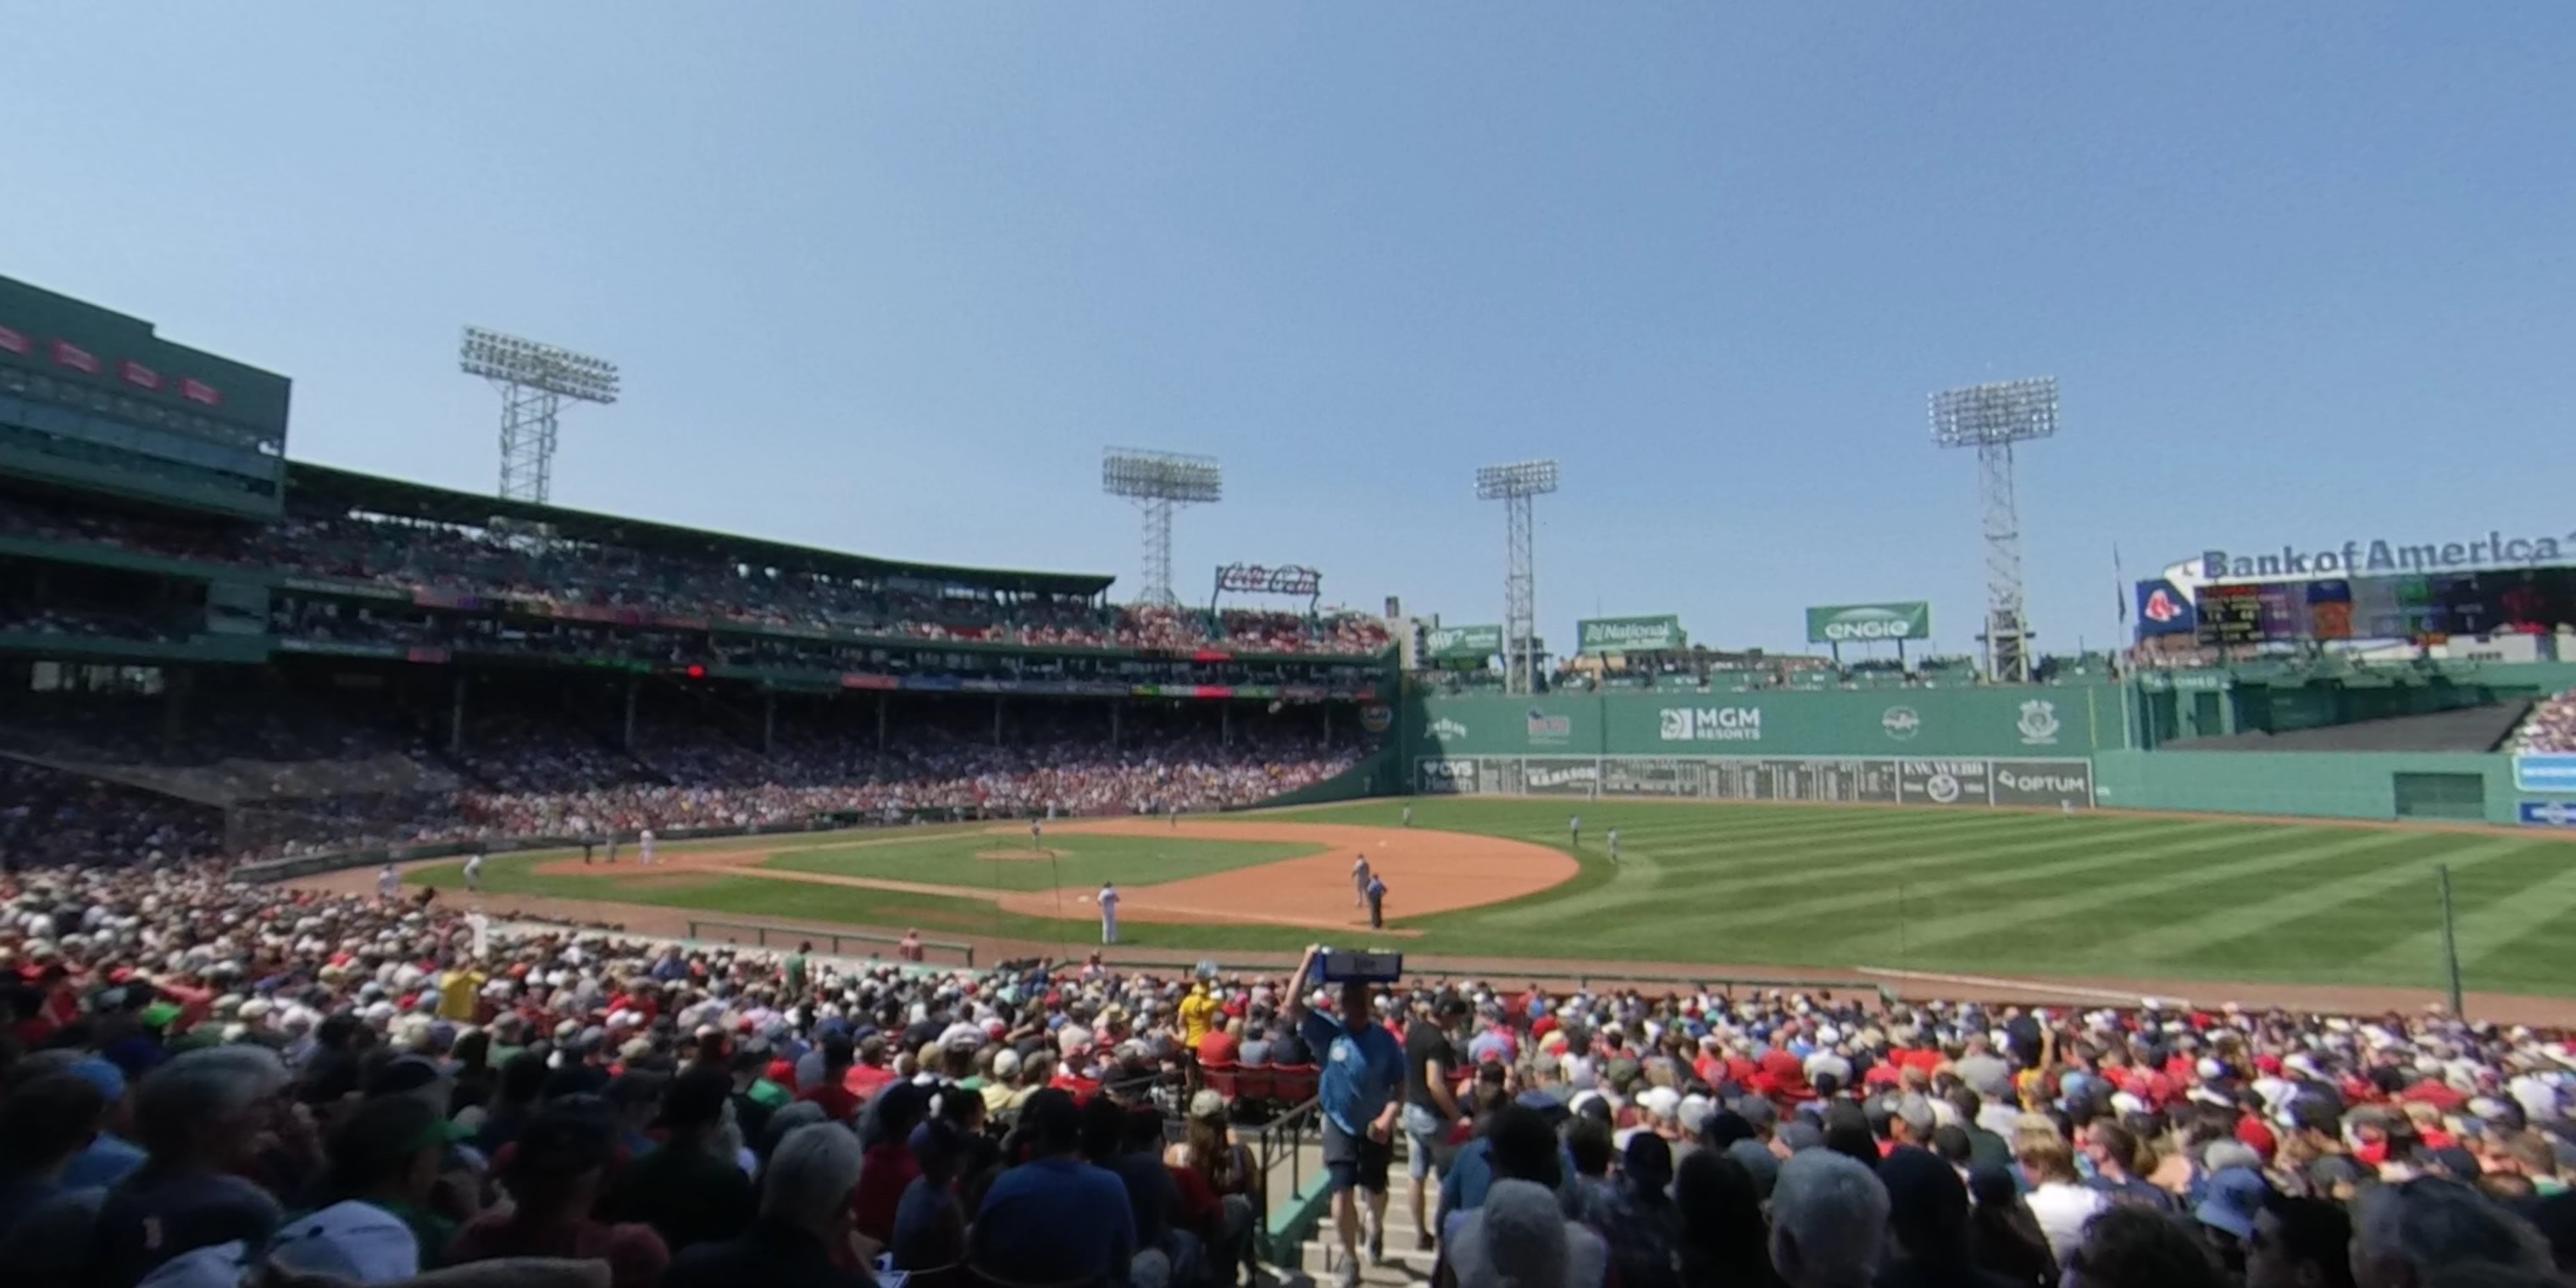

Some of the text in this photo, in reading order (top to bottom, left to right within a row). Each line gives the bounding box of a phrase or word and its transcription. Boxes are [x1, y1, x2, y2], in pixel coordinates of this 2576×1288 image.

[2203, 531, 2561, 578] Bank of America
[1696, 708, 1760, 728] MGM
[1696, 729, 1761, 740] RESORTS
[1439, 760, 1473, 776] CVS
[2018, 775, 2085, 791] OPTUM
